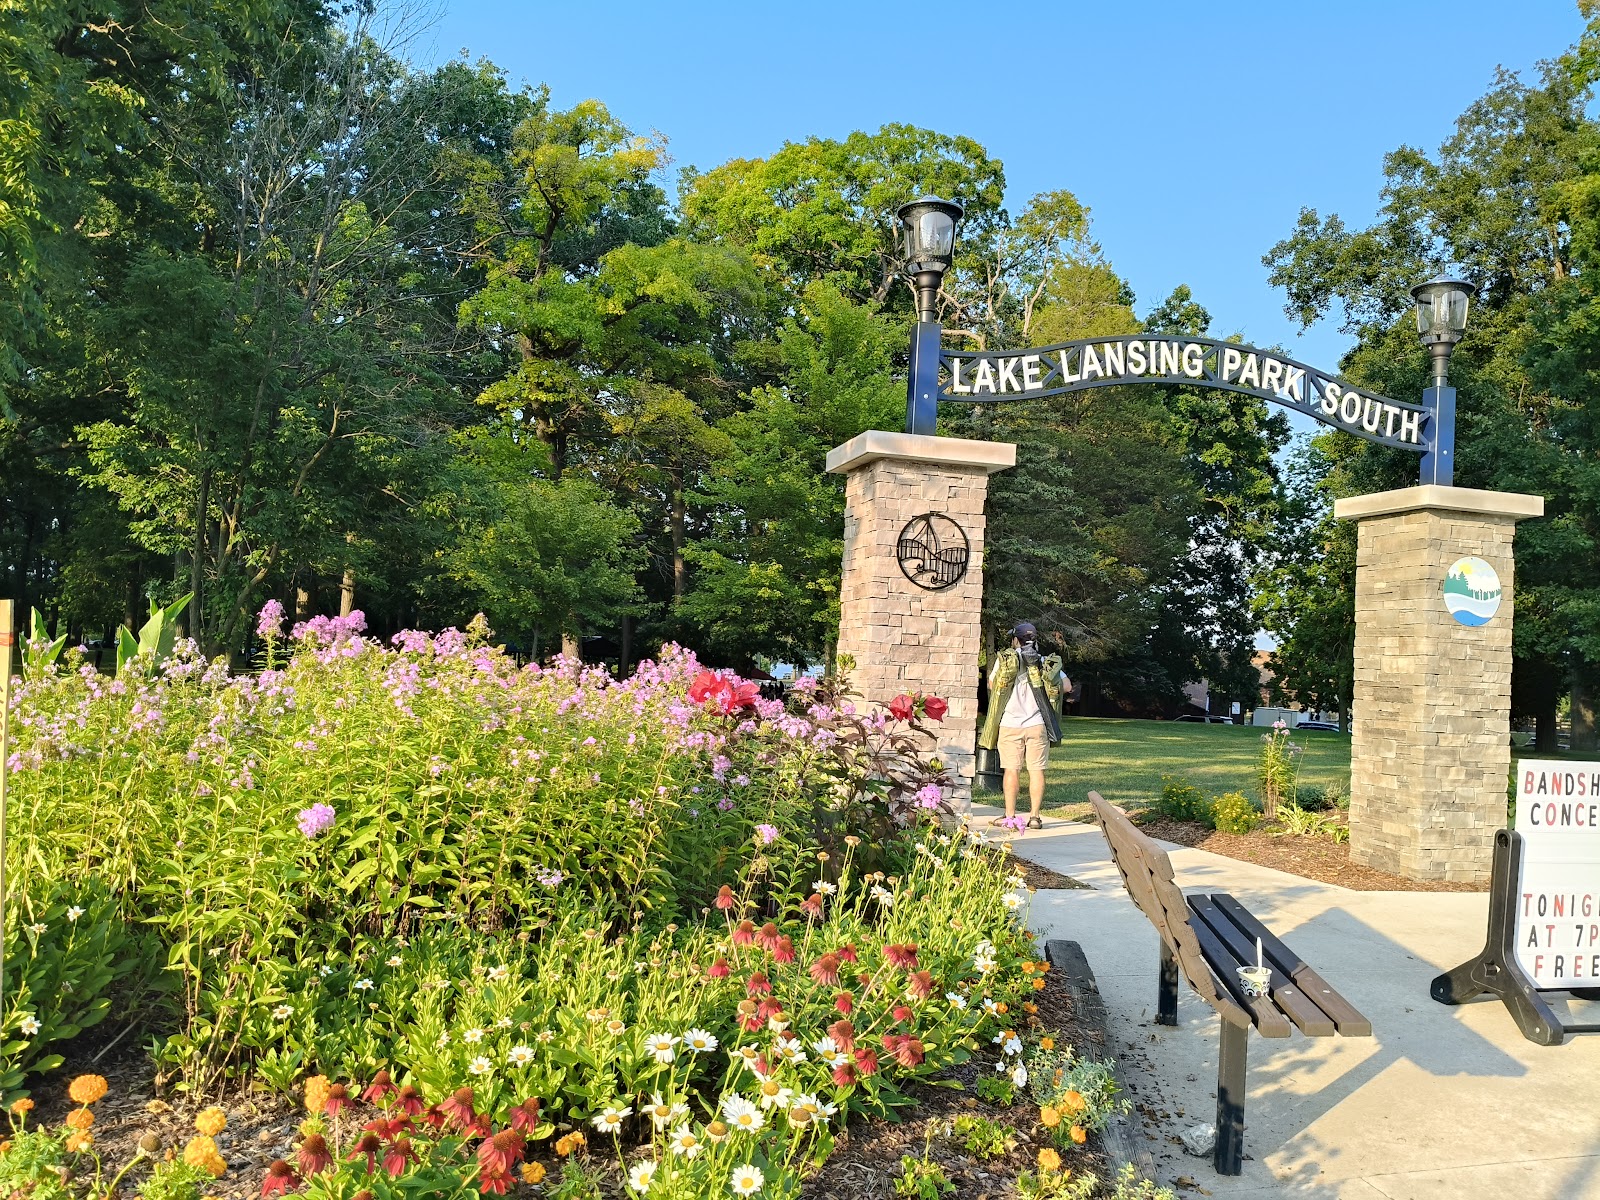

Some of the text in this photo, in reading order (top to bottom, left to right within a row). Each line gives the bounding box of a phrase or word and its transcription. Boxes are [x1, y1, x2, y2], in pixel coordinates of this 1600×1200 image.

[953, 340, 1420, 443] LAKE LANSING PARK SOUTH
[1523, 893, 1600, 917] TONIG
[1528, 924, 1556, 948] AT
[1535, 955, 1600, 978] FREE
